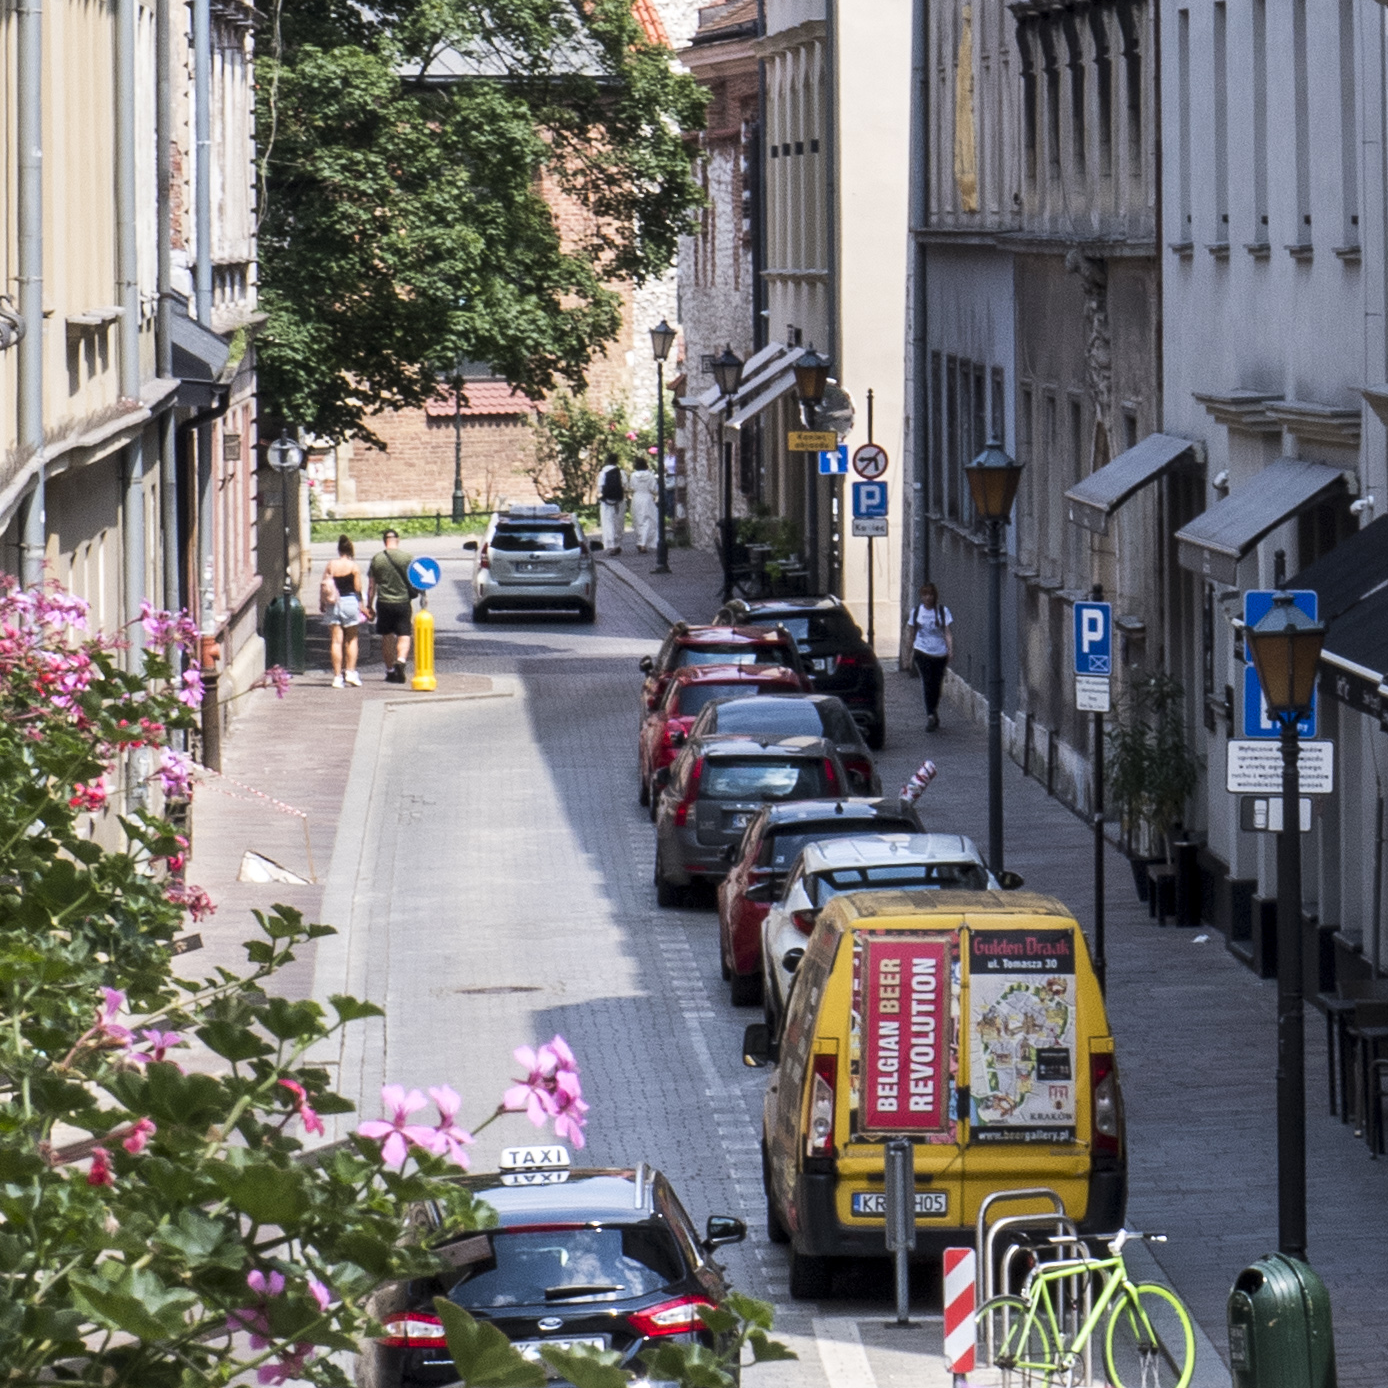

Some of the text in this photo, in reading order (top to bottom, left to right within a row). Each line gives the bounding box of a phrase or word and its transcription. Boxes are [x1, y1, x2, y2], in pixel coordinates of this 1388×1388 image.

[860, 485, 880, 513] P
[856, 523, 884, 531] Koiec
[1082, 608, 1104, 653] P
[973, 936, 1070, 955] Gulden Draak
[987, 958, 1058, 968] ul. Tomasza 30
[877, 958, 901, 1112] BELGIAN BEER
[909, 957, 937, 1112] REVOLUTION
[978, 1130, 1069, 1142] www.beergallery.pl
[509, 1149, 561, 1166] TAXI
